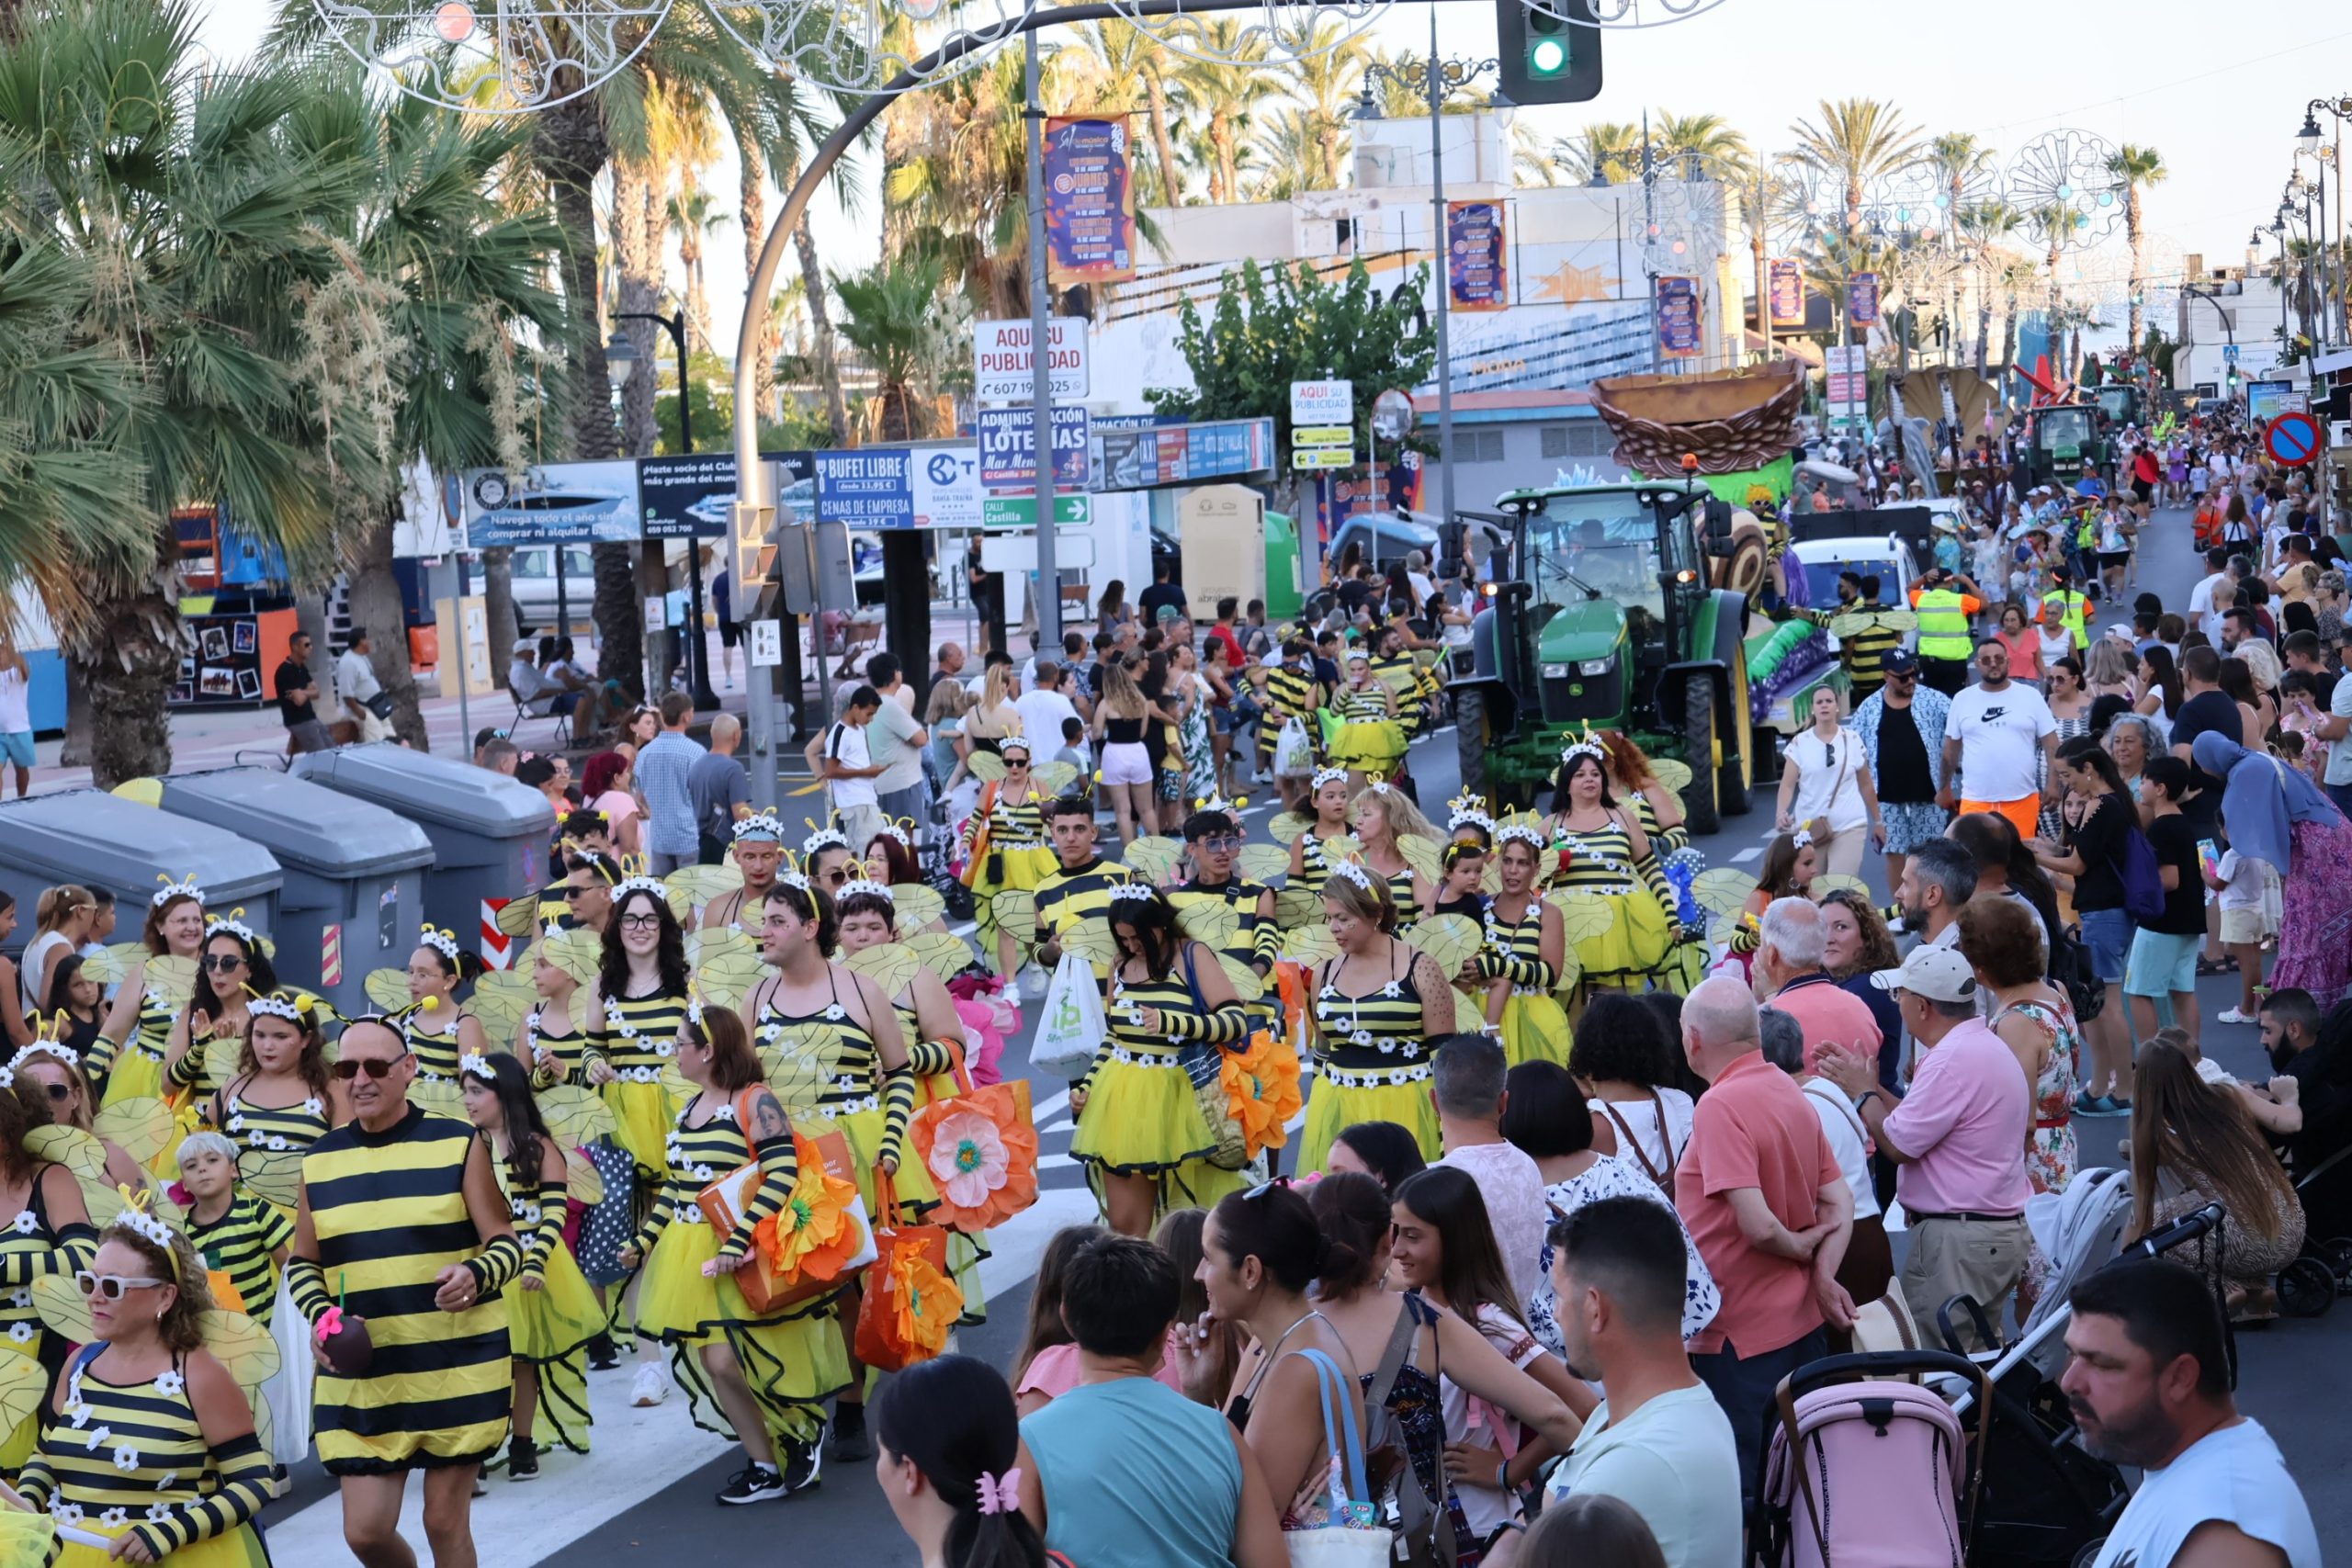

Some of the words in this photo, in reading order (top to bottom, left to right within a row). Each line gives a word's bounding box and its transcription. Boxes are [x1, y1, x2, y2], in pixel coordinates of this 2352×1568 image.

[996, 327, 1032, 348] AQU
[981, 350, 1080, 372] PUBLICDAD
[994, 382, 1017, 394] 607
[1330, 388, 1343, 398] SU
[1295, 399, 1347, 410] PUBLICIDAD
[981, 409, 1083, 427] ADMINISACIÓN
[1091, 418, 1138, 431] RMACIÓN
[984, 425, 1086, 452] LOTEÍAS
[673, 463, 697, 473] socio
[699, 462, 714, 471] del
[716, 461, 736, 471] Club
[982, 454, 1007, 469] Mar
[1009, 453, 1036, 468] Men
[829, 459, 865, 479] BUFET
[867, 457, 902, 478] LIBRE
[643, 477, 662, 486] más
[664, 475, 695, 487] grande
[698, 474, 713, 483] del
[821, 500, 851, 516] CENAS
[854, 500, 865, 514] DE
[866, 499, 910, 514] EMPRESA
[986, 502, 1004, 512] CALLE
[491, 515, 531, 526] Navega
[535, 513, 560, 524] todo
[561, 513, 571, 522] el
[575, 512, 595, 523] año
[597, 512, 614, 521] sin
[986, 513, 1021, 523] Castilla
[487, 529, 532, 540] comprar
[534, 527, 545, 537] ni
[548, 525, 590, 538] alquilar
[679, 525, 693, 533] 700
[1985, 706, 2007, 716] NIKE
[823, 1158, 837, 1170] por
[826, 1167, 842, 1176] rme
